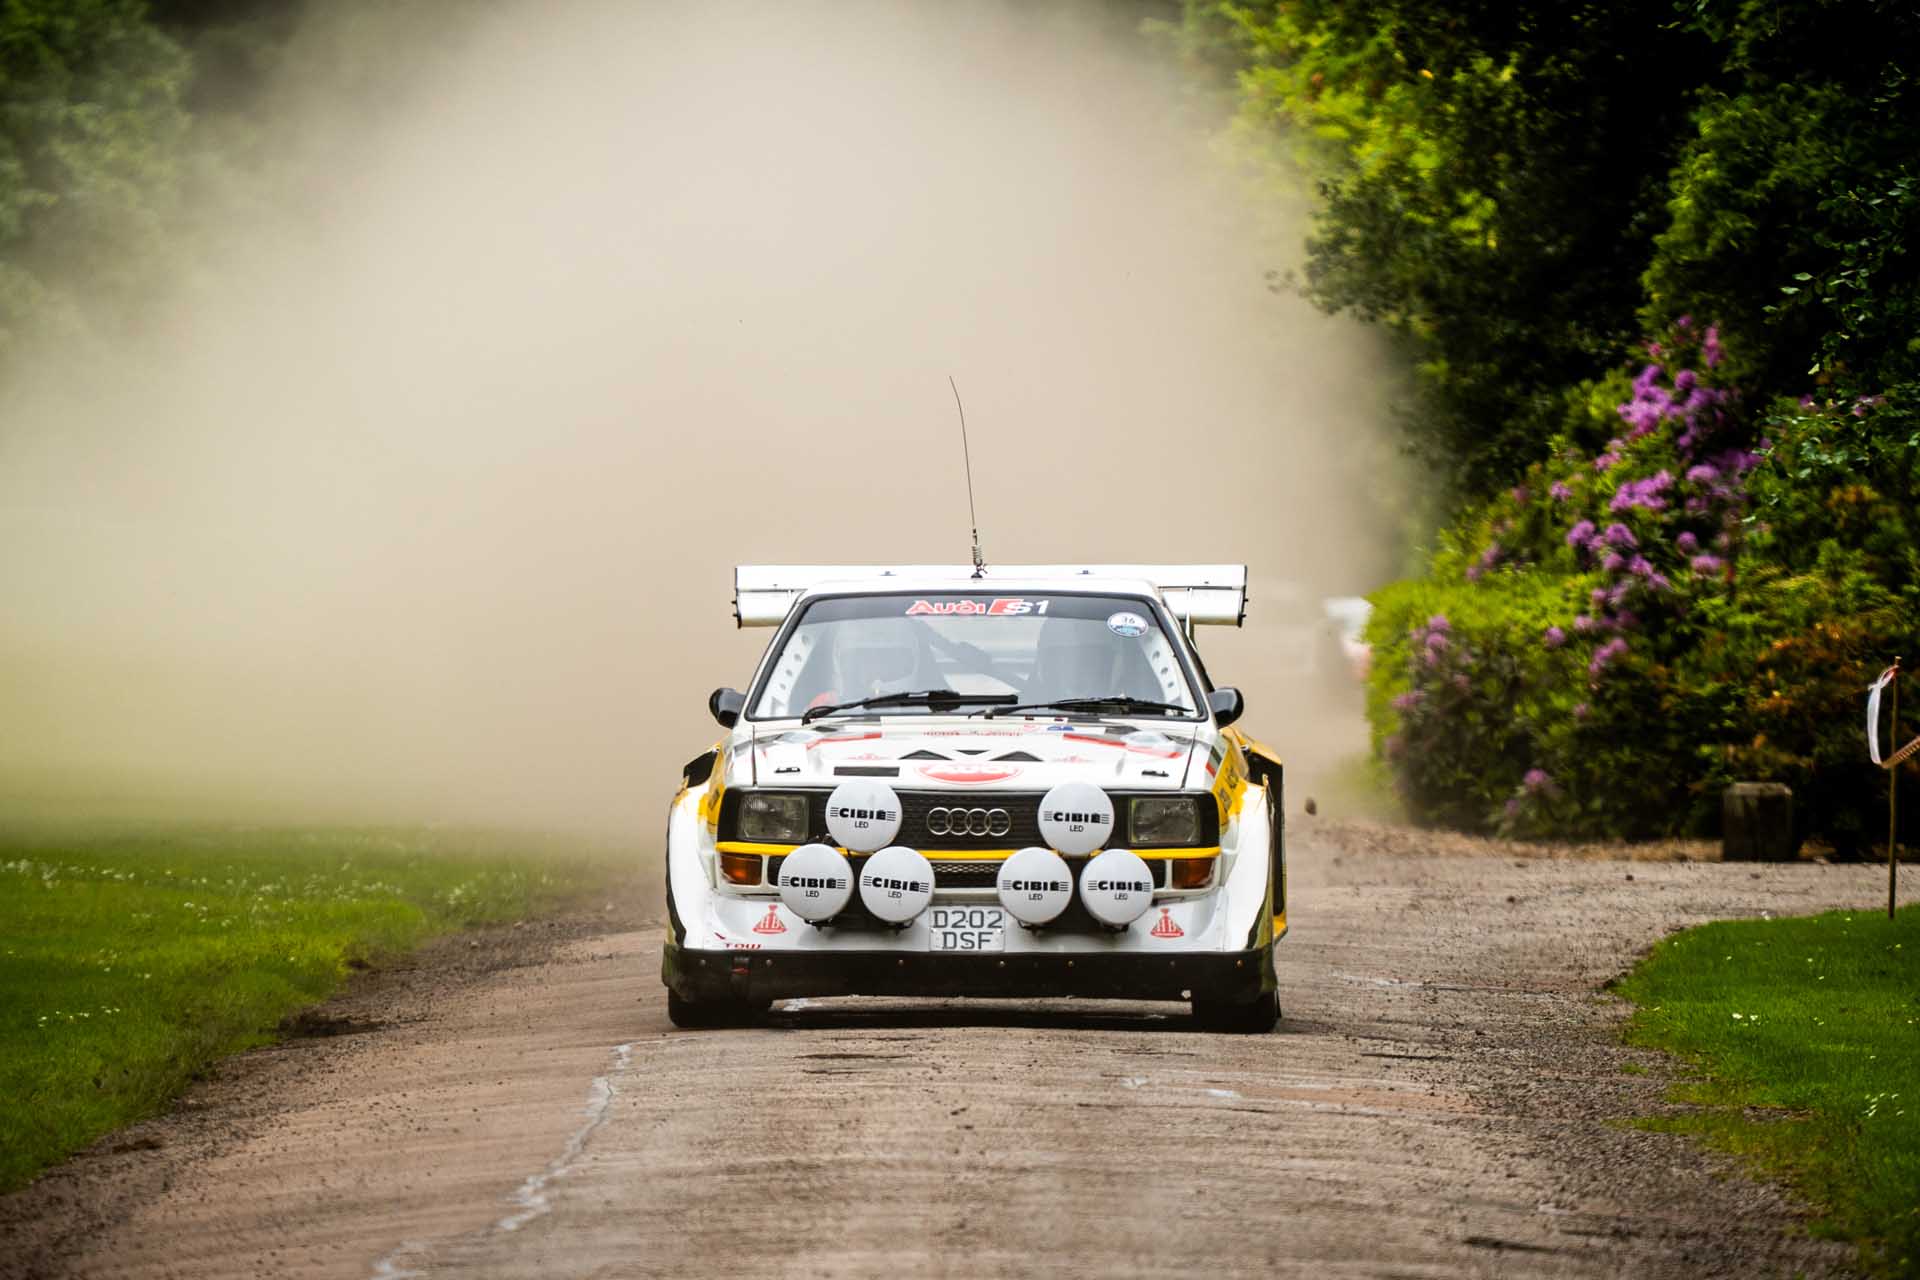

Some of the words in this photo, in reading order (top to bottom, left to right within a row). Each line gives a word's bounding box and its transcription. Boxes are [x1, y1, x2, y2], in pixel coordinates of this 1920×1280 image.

[1003, 599, 1049, 615] S1
[854, 820, 869, 829] LED
[1069, 825, 1084, 833] LED
[805, 890, 820, 898] LED
[887, 891, 902, 899] LED
[1028, 893, 1043, 901] LED
[933, 910, 1002, 928] D202
[942, 931, 993, 949] DSF
